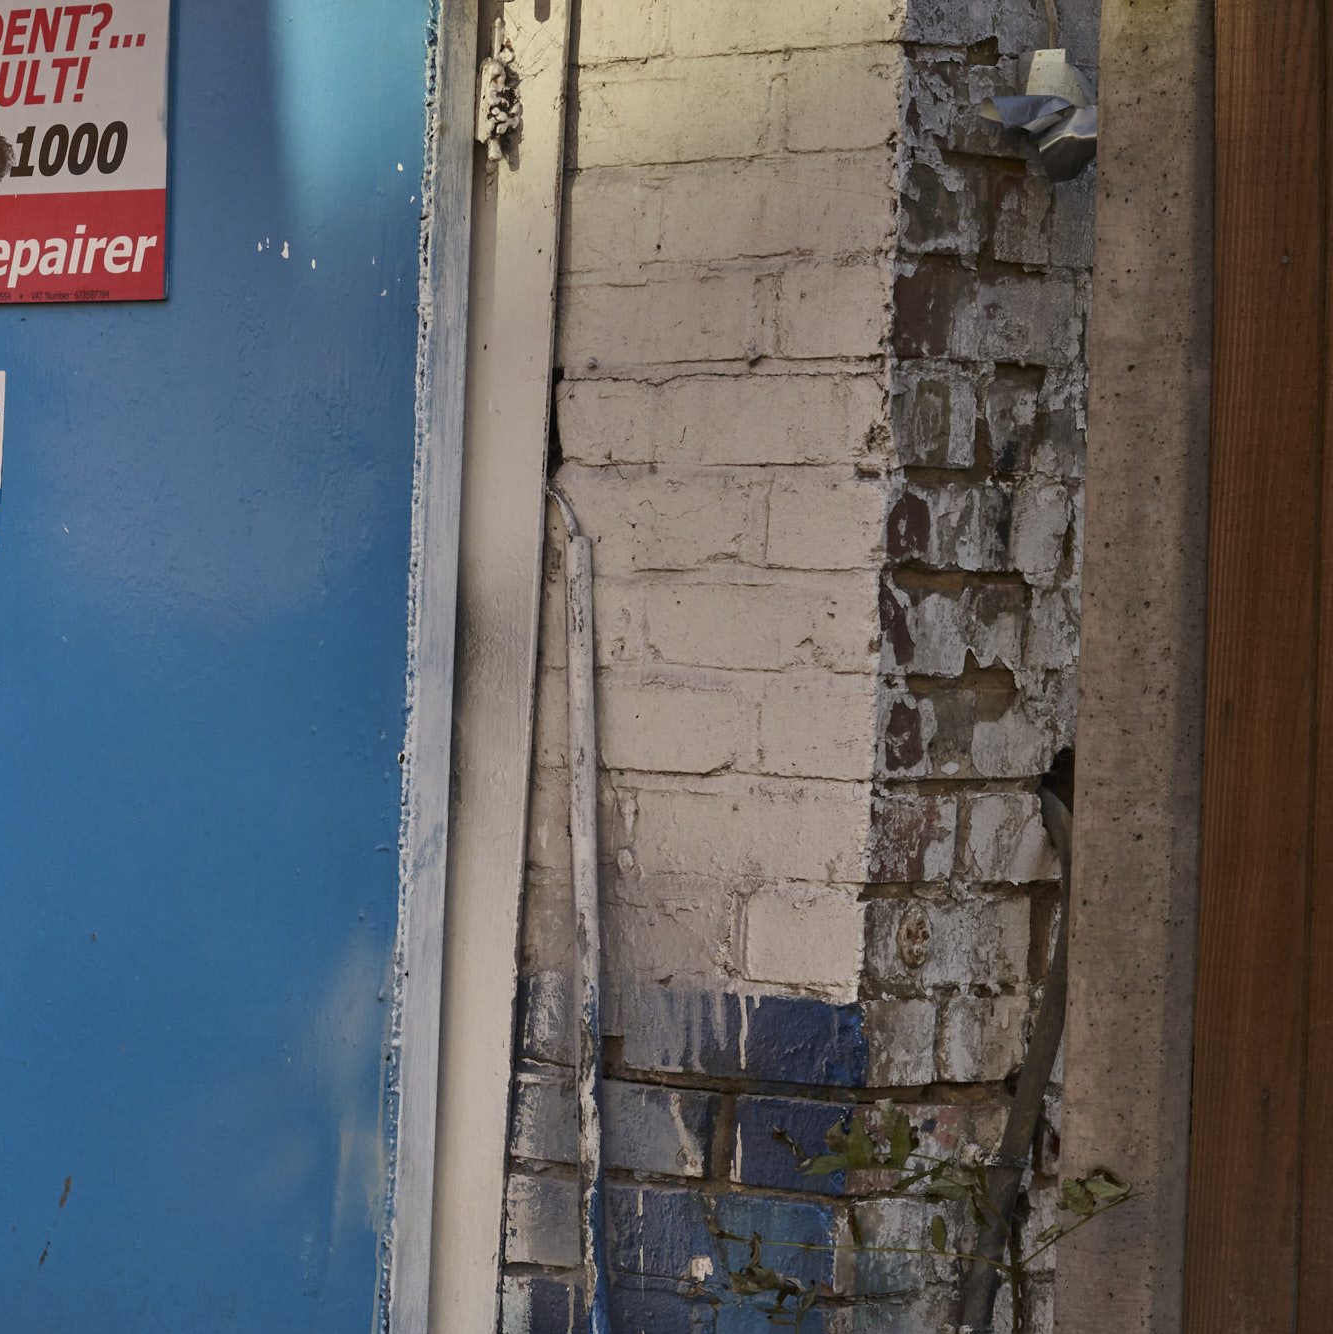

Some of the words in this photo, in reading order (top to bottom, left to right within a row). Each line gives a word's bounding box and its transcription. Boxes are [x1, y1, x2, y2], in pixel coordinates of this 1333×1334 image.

[10, 121, 128, 177] 1000
[31, 291, 43, 300] VAT
[45, 291, 72, 300] Number:
